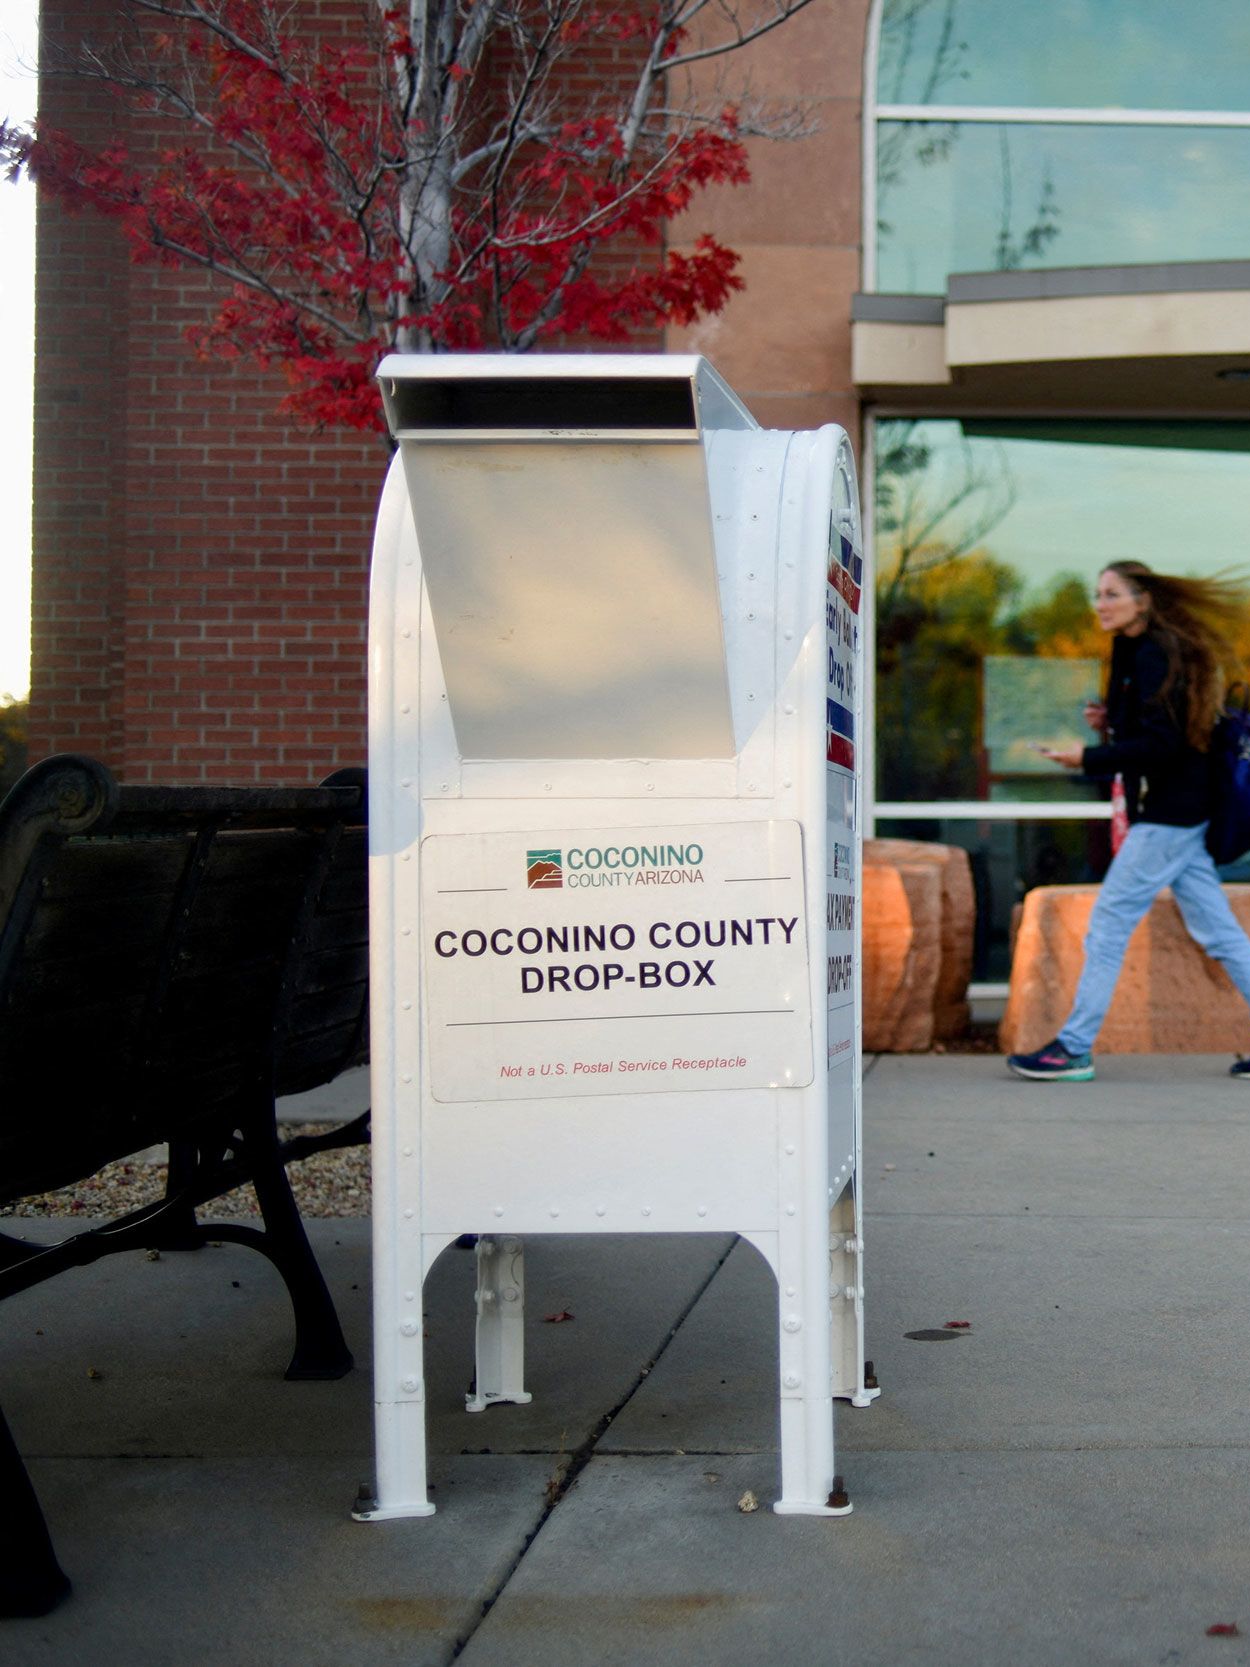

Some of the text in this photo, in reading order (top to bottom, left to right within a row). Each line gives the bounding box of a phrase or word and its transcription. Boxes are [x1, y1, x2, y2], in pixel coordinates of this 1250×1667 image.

[829, 646, 844, 700] Drop
[566, 843, 704, 870] COCONINO
[434, 917, 799, 958] COCONINO COUNTY
[520, 959, 717, 994] DROP-BOX
[500, 1056, 747, 1078] Not a U.S. Postal Service Receptacle
